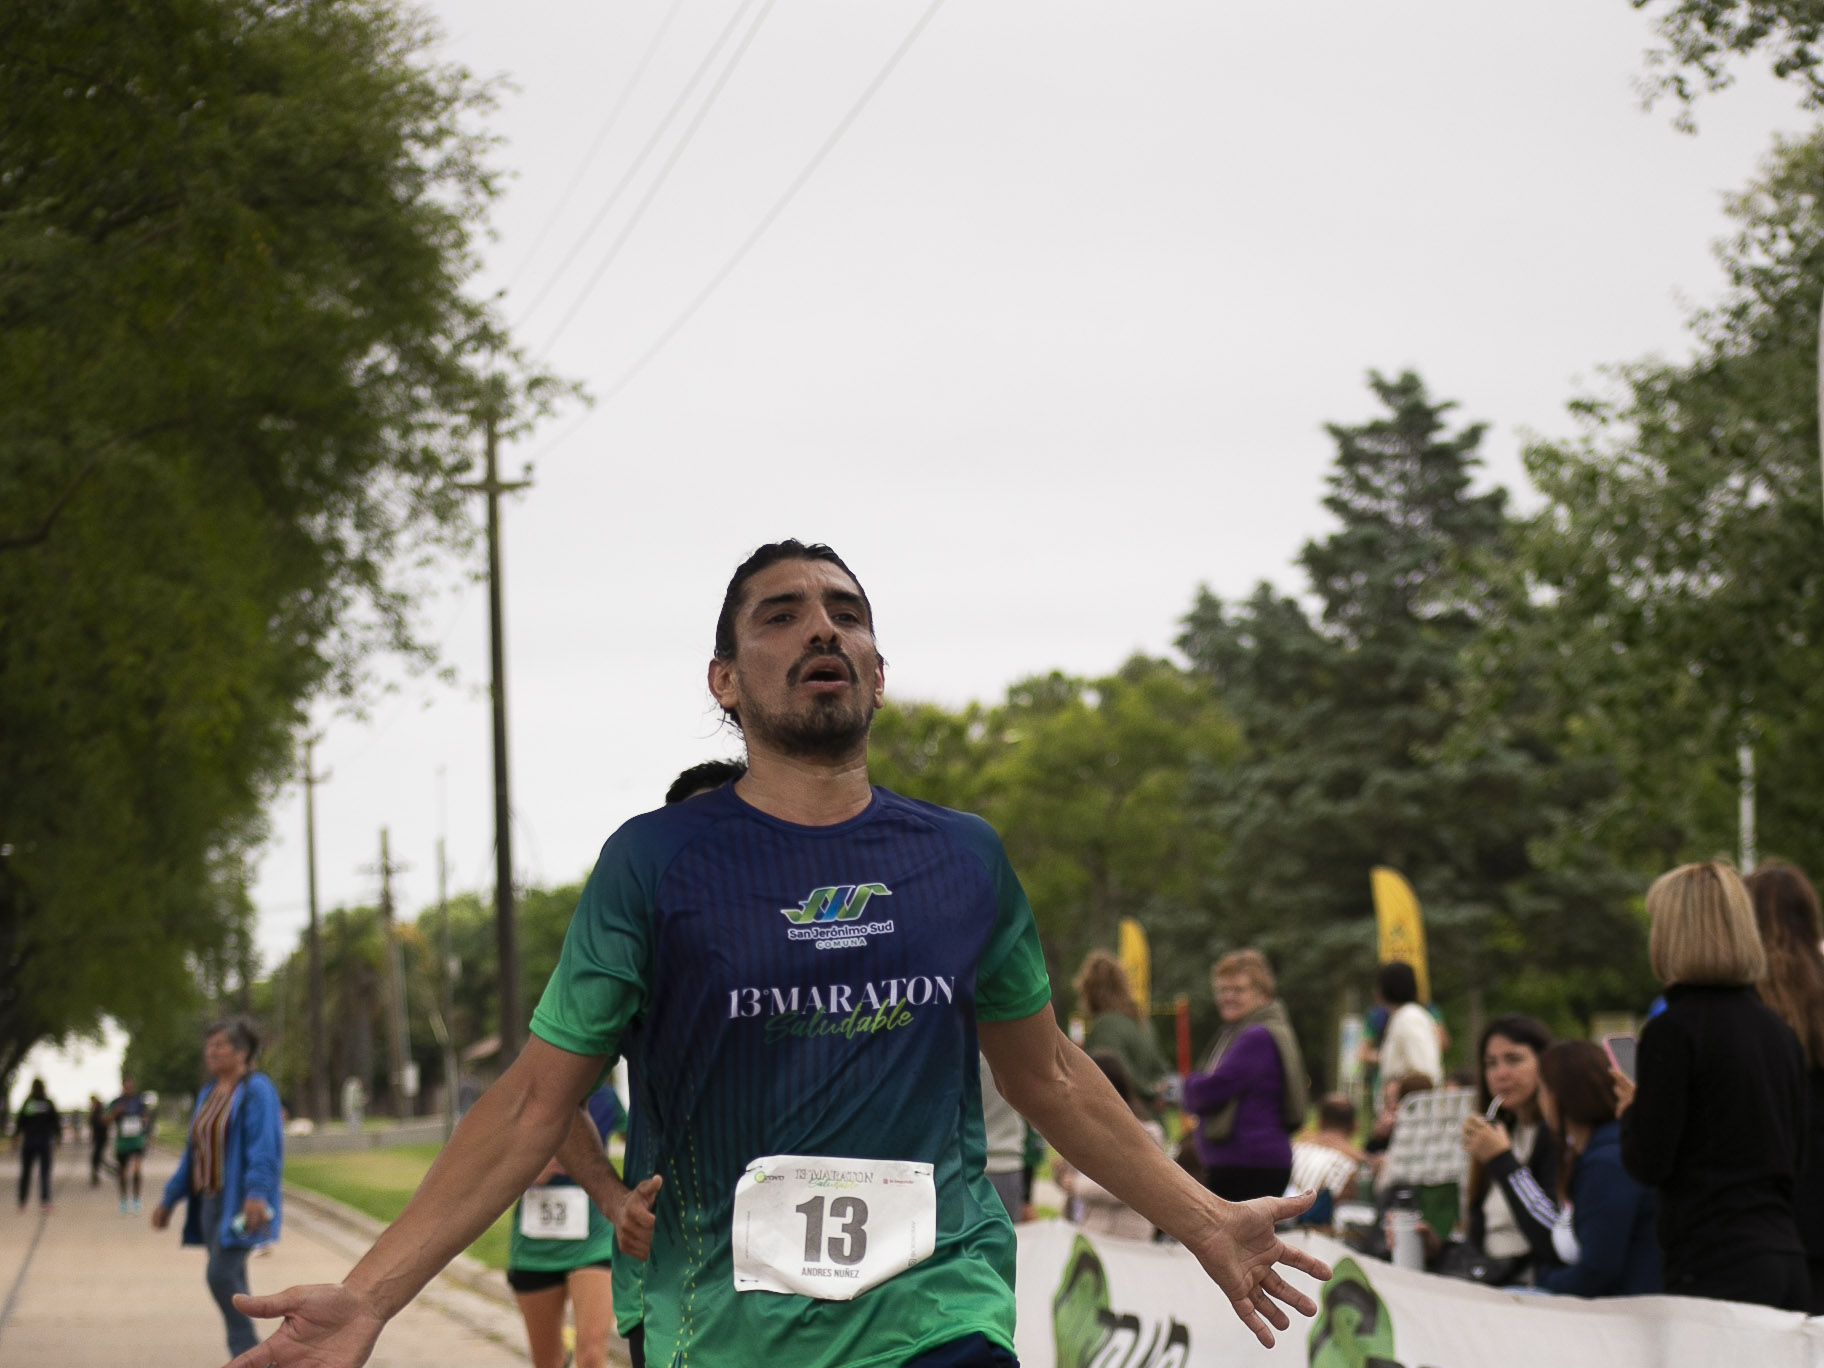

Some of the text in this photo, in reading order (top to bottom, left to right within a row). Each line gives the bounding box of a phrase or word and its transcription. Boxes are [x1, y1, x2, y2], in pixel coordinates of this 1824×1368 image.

[788, 921, 894, 939] San Jerónimo Sud
[816, 938, 867, 949] COMUNA
[764, 997, 914, 1044] Saludable
[795, 1195, 869, 1266] 13
[802, 1267, 860, 1279] ANDRES NUÑEZ
